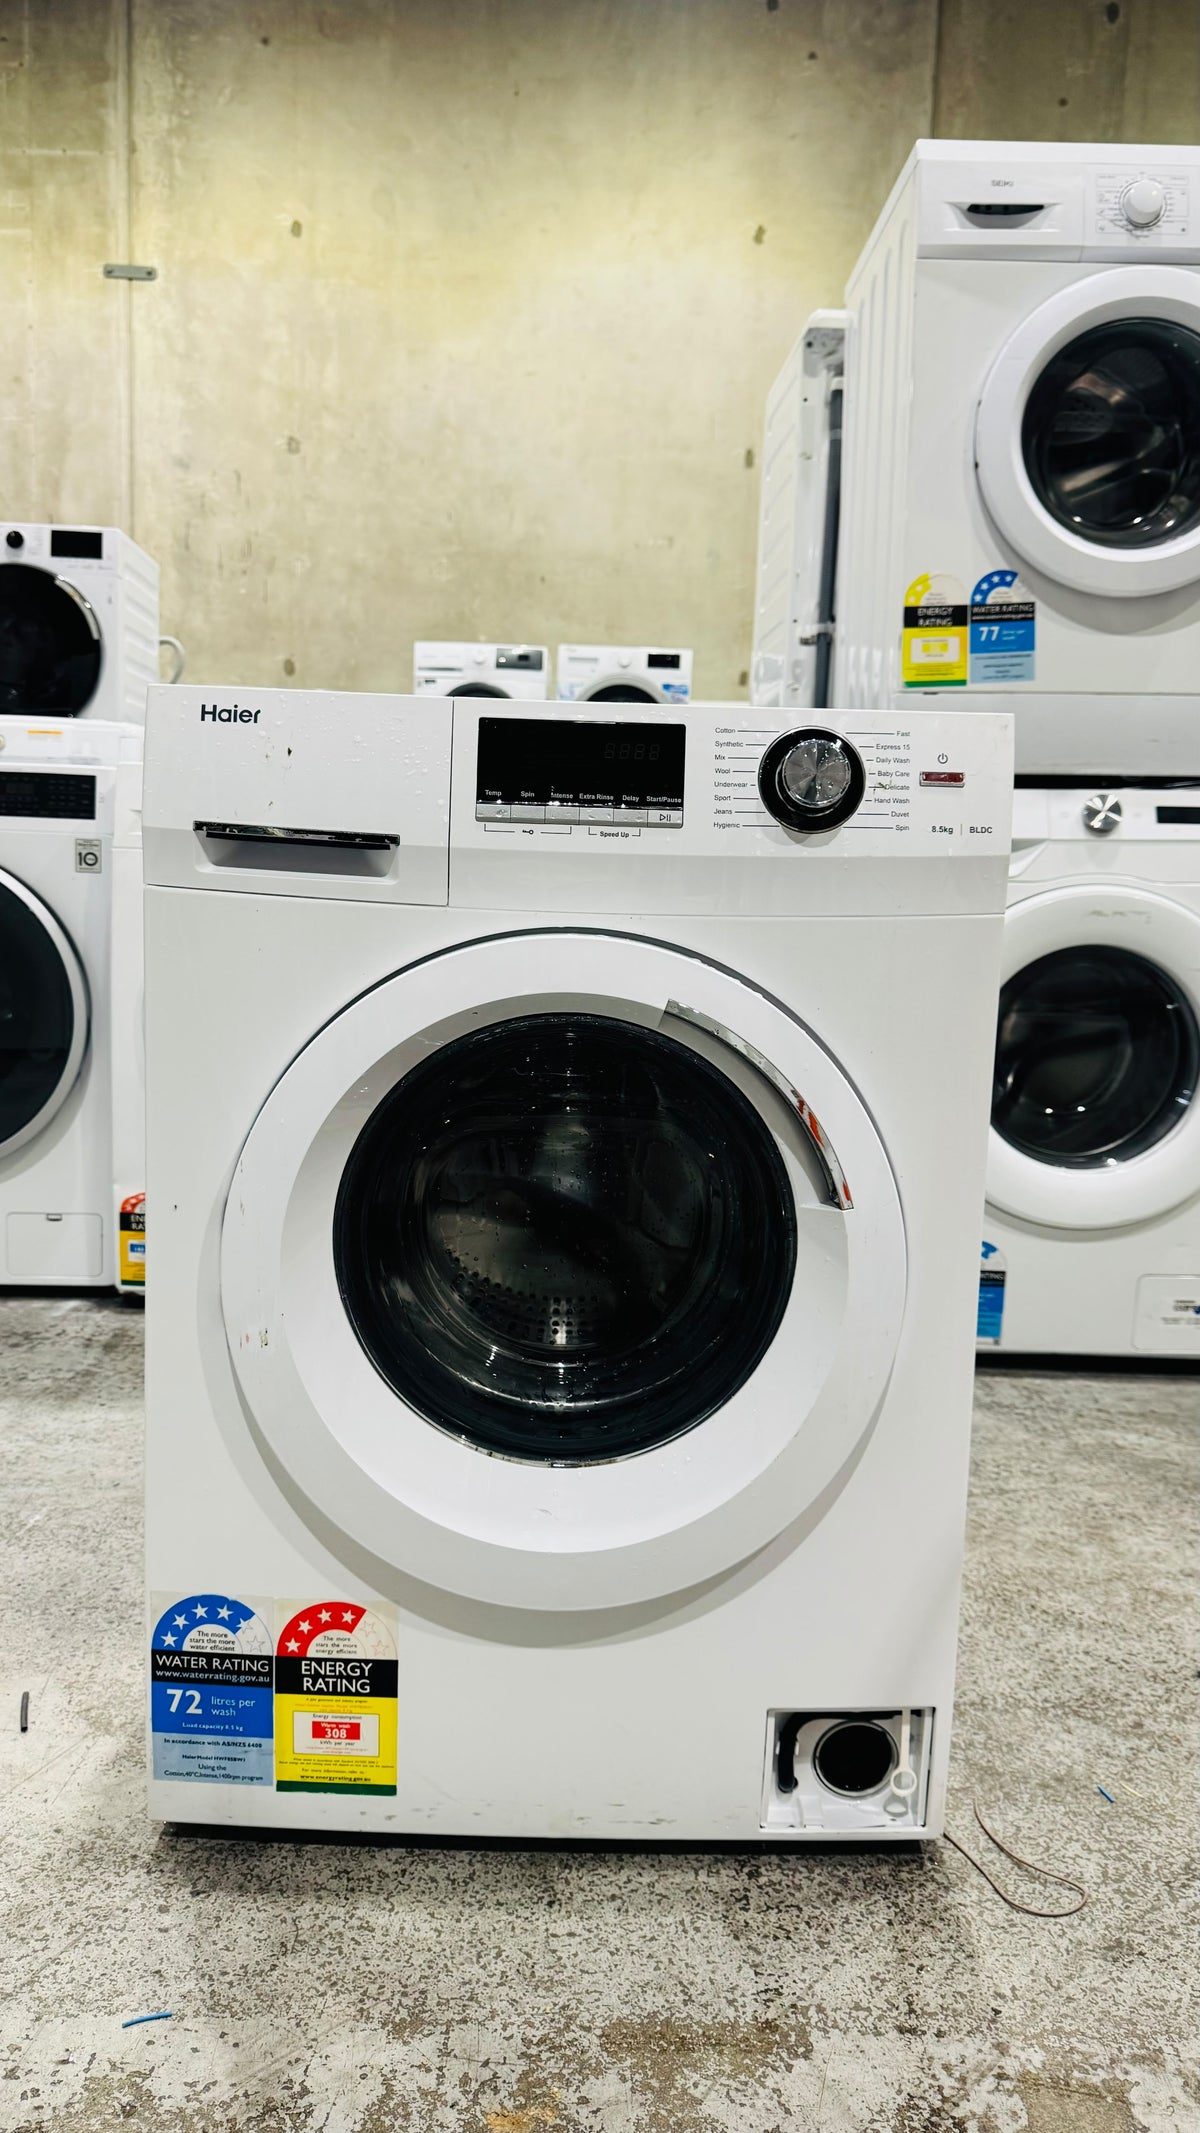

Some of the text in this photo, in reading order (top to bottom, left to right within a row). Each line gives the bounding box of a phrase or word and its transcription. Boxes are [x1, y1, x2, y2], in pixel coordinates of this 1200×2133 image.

[979, 626, 1000, 641] 77
[200, 703, 261, 723] Haier
[714, 740, 744, 748] Synthetic
[877, 770, 894, 778] Baby
[520, 790, 535, 798] Spin
[622, 794, 640, 802] Delay
[646, 795, 682, 803] Start/Pause
[931, 826, 954, 834] 8.5kg
[969, 826, 993, 834] BLDC
[78, 851, 98, 866] 10
[209, 1644, 235, 1652] efficient
[156, 1654, 269, 1672] WATER RATING
[301, 1660, 373, 1677] ENERGY
[156, 1670, 270, 1684] www.waterrating.gov.au
[303, 1677, 370, 1694] RATING
[166, 1688, 203, 1715] 72
[211, 1696, 256, 1708] litres per
[210, 1707, 236, 1716] wash
[198, 1723, 224, 1731] capacity
[324, 1728, 347, 1739] 308
[198, 1764, 216, 1772] Using
